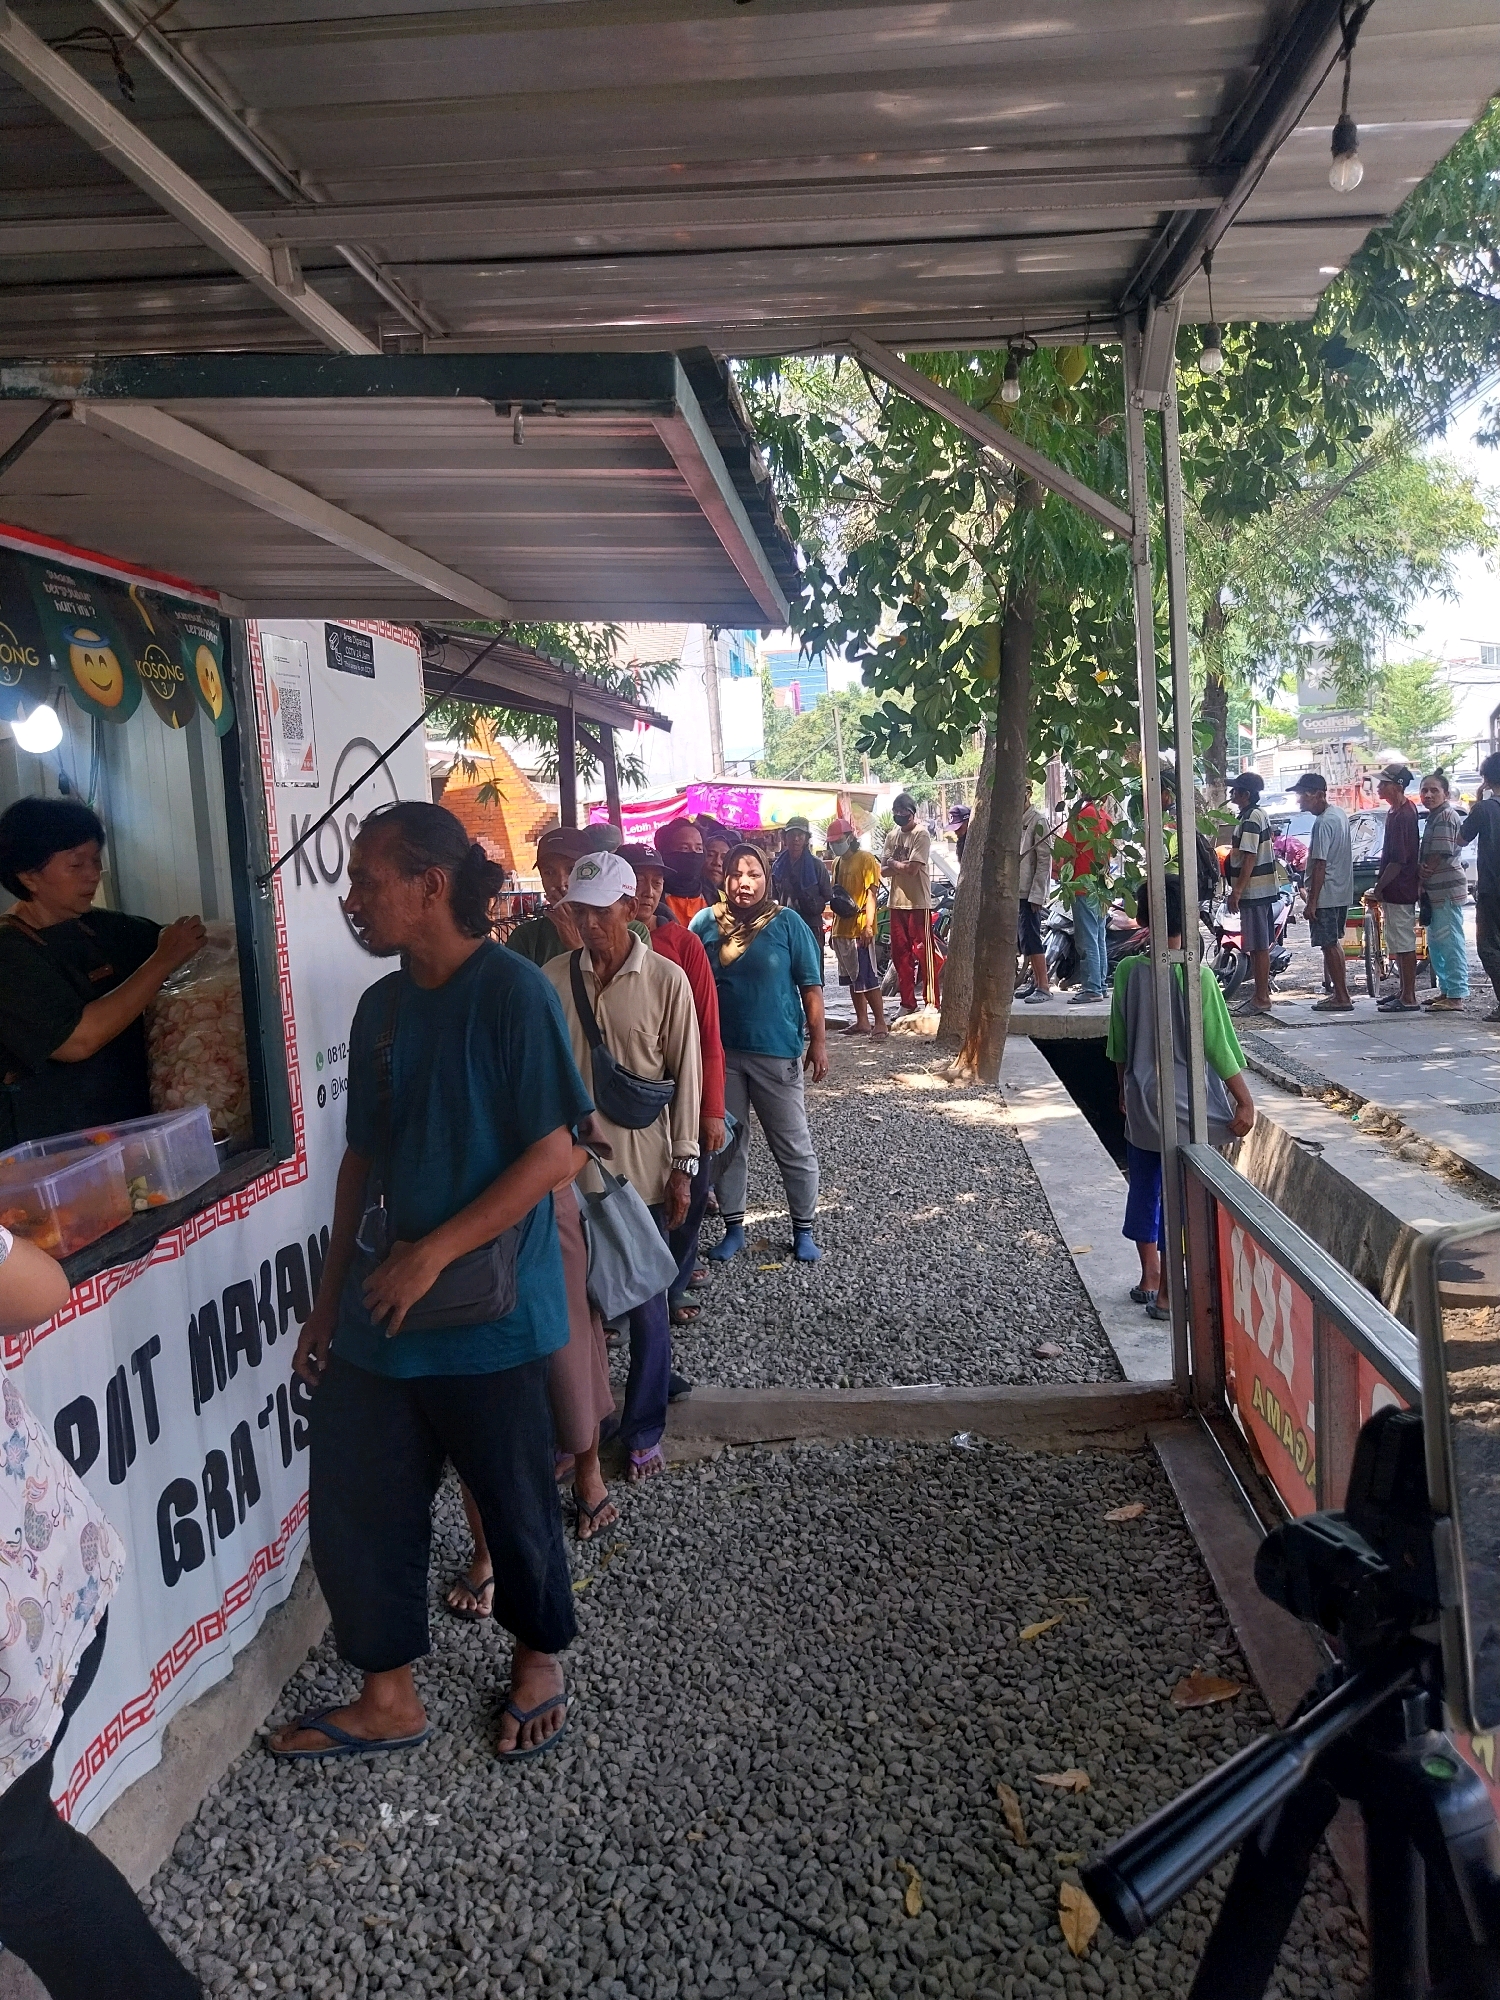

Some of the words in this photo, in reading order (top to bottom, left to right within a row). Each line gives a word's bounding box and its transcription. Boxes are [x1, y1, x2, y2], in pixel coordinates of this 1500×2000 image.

[54, 599, 76, 614] hari
[0, 643, 40, 667] ONG
[2, 665, 12, 682] 3
[135, 659, 185, 681] KOSONG
[161, 681, 169, 696] 3
[623, 822, 652, 835] Lebih
[291, 811, 359, 887] KOS
[327, 1041, 350, 1065] 0812-
[331, 1076, 348, 1101] @ko
[156, 1370, 312, 1588] GRAIS
